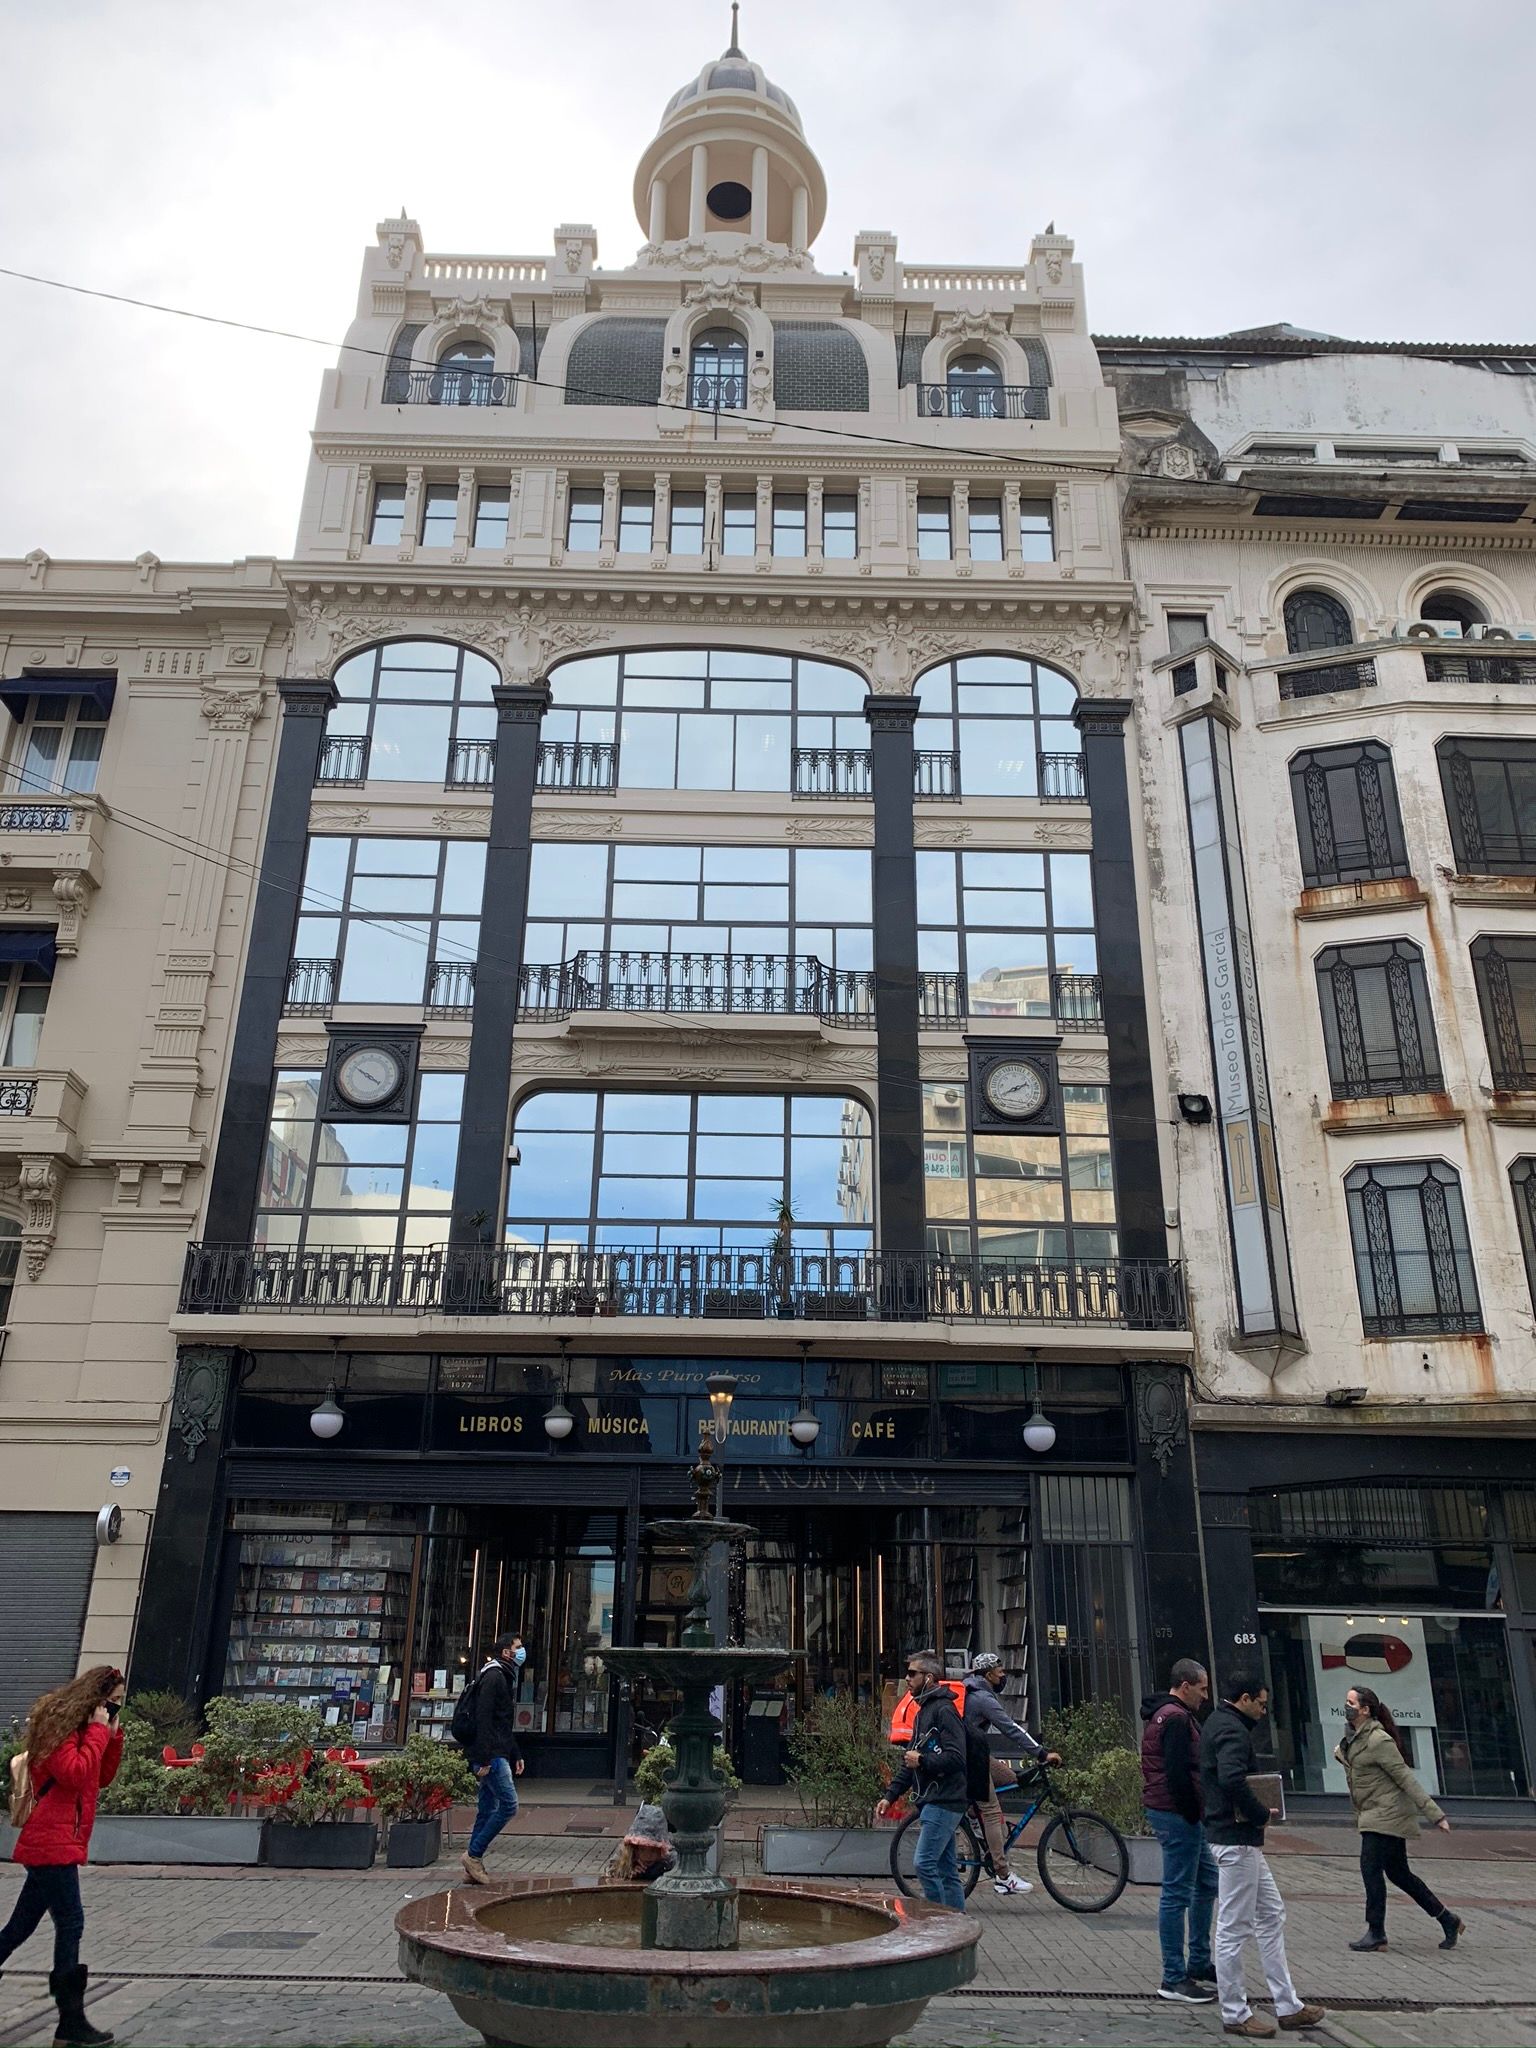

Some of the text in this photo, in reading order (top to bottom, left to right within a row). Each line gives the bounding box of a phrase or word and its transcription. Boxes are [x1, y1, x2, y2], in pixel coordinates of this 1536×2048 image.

[1210, 930, 1243, 1111] Museo Torres García
[1254, 1052, 1268, 1113] Museo
[609, 1368, 652, 1382] Más
[657, 1369, 704, 1382] Puro
[460, 1416, 523, 1433] LIBROS
[588, 1413, 649, 1435] MÚSICA
[698, 1419, 794, 1437] RETAURANTE
[851, 1417, 896, 1439] CAFÉ
[1233, 1633, 1257, 1645] 683
